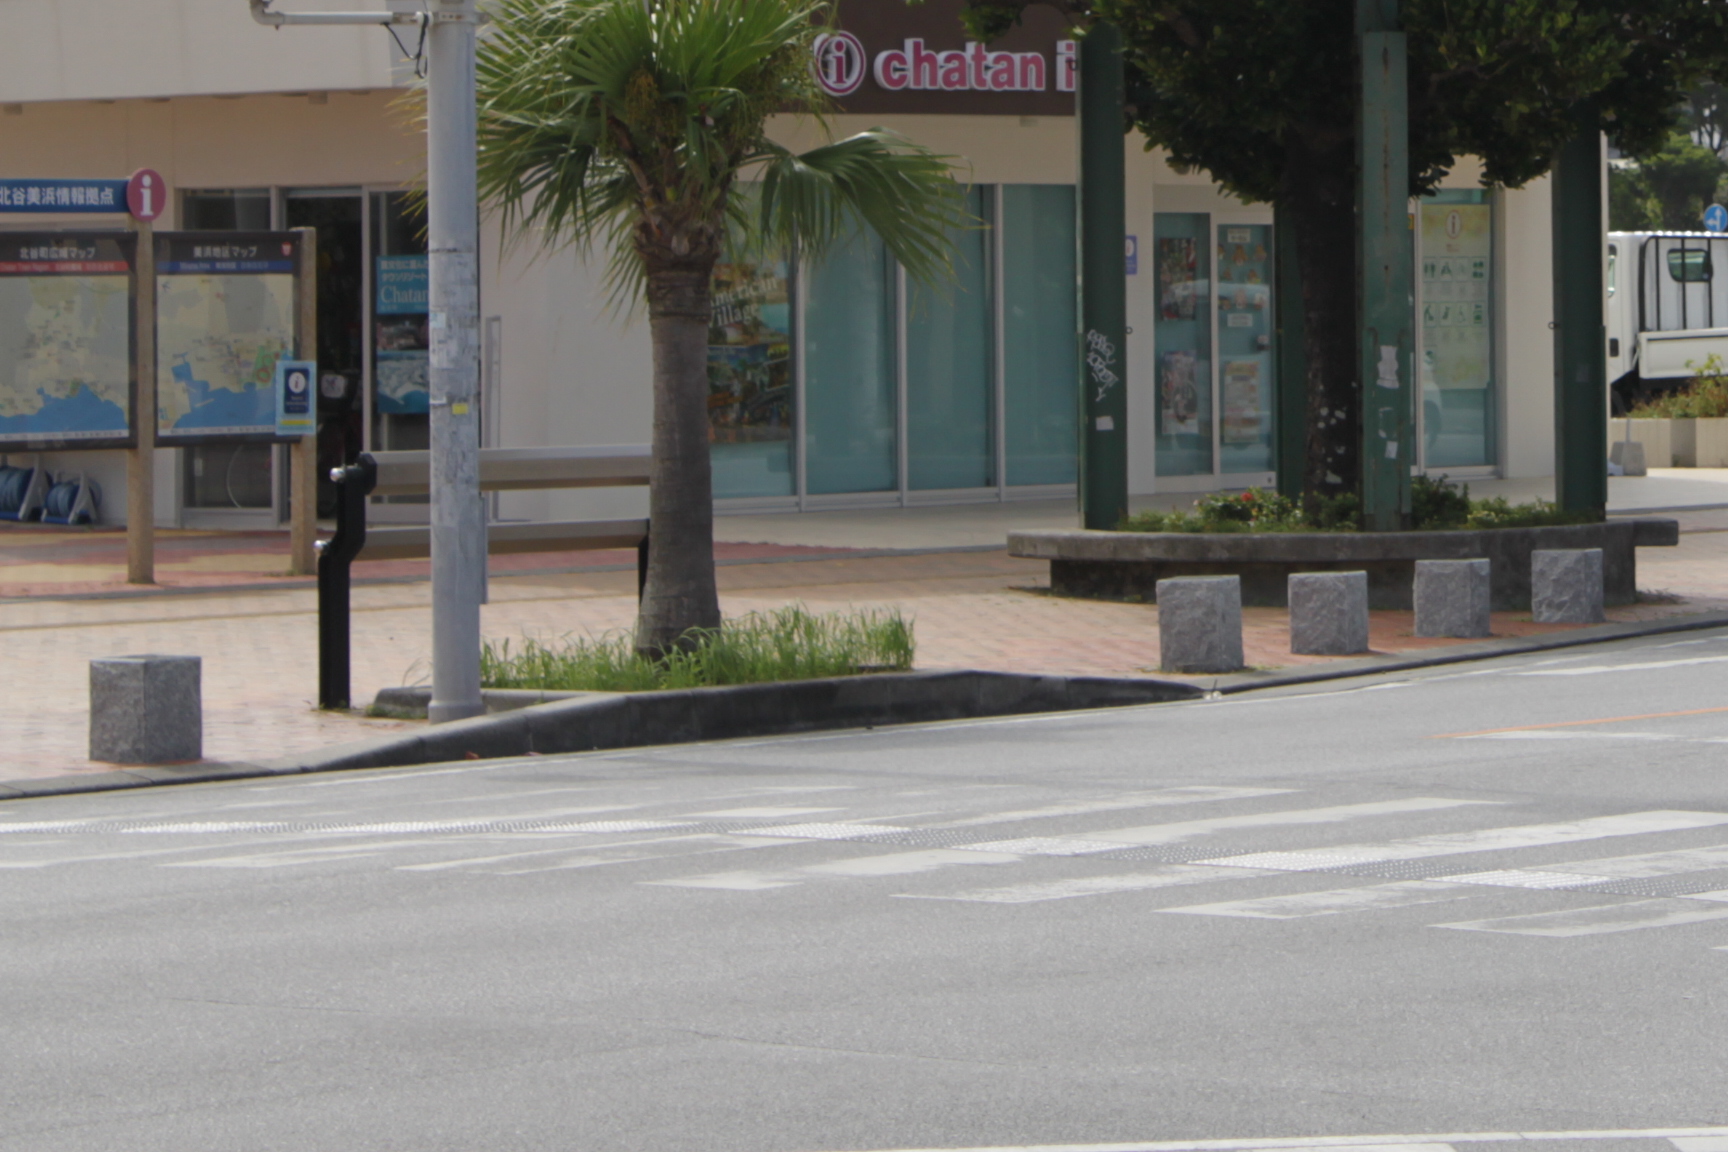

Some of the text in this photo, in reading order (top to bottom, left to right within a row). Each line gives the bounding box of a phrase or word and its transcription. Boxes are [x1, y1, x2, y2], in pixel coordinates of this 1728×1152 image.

[876, 37, 1046, 91] chatan
[0, 186, 114, 206] 北谷美浜情報拠点
[710, 278, 778, 308] merican
